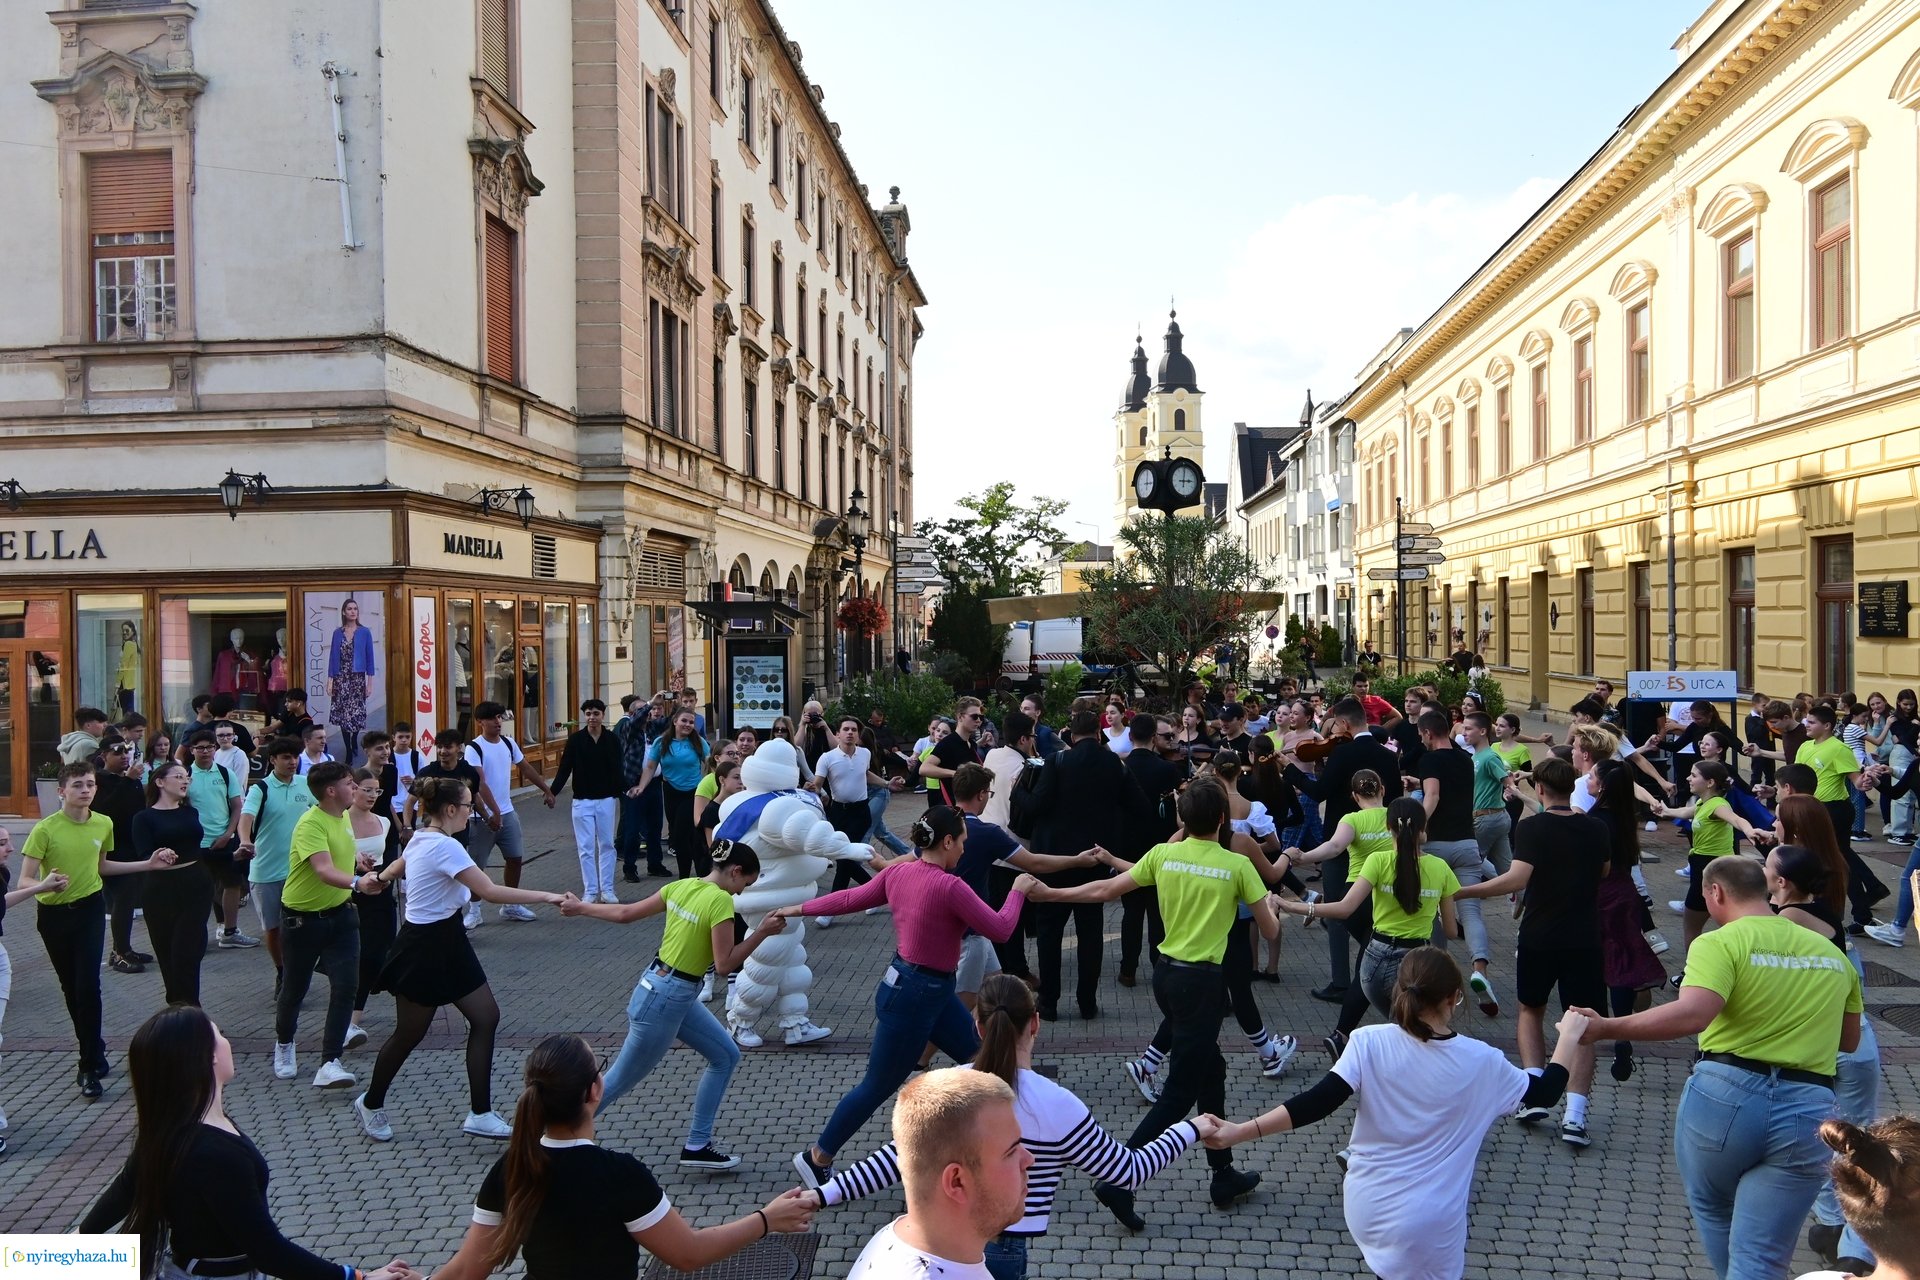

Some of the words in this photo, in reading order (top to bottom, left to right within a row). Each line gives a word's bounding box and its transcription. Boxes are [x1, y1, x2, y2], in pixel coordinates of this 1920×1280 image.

[443, 532, 504, 560] MARELLA
[309, 606, 324, 697] BARCLAY
[416, 612, 434, 680] Cooper
[416, 683, 433, 714] Lee
[1690, 679, 1725, 690] UTCA
